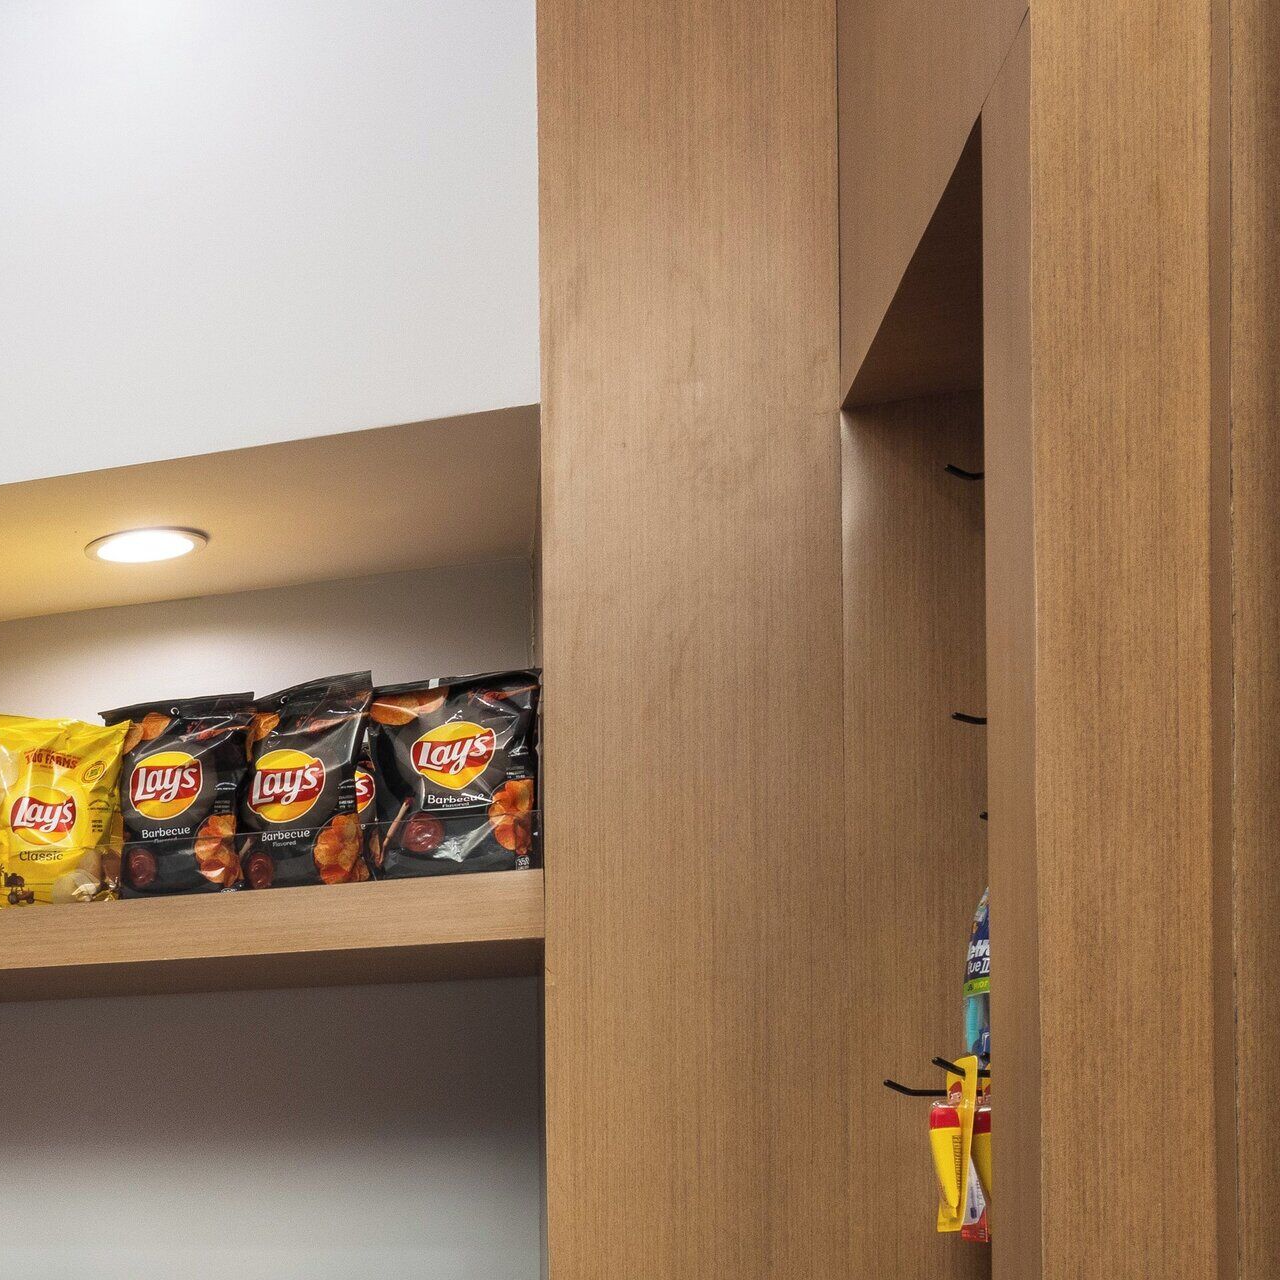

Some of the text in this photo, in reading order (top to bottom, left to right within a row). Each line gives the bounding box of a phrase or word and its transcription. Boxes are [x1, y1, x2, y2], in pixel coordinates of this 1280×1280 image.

[45, 753, 80, 769] FARMS
[418, 733, 490, 775] Lay's
[134, 765, 197, 804] Lay's
[252, 763, 320, 805] Lay's
[427, 792, 485, 804] Barbecue
[13, 796, 74, 833] Lay's
[141, 826, 191, 839] Barbecue
[261, 828, 311, 842] Barbecue
[272, 840, 297, 848] Flavored
[19, 850, 64, 862] Classic
